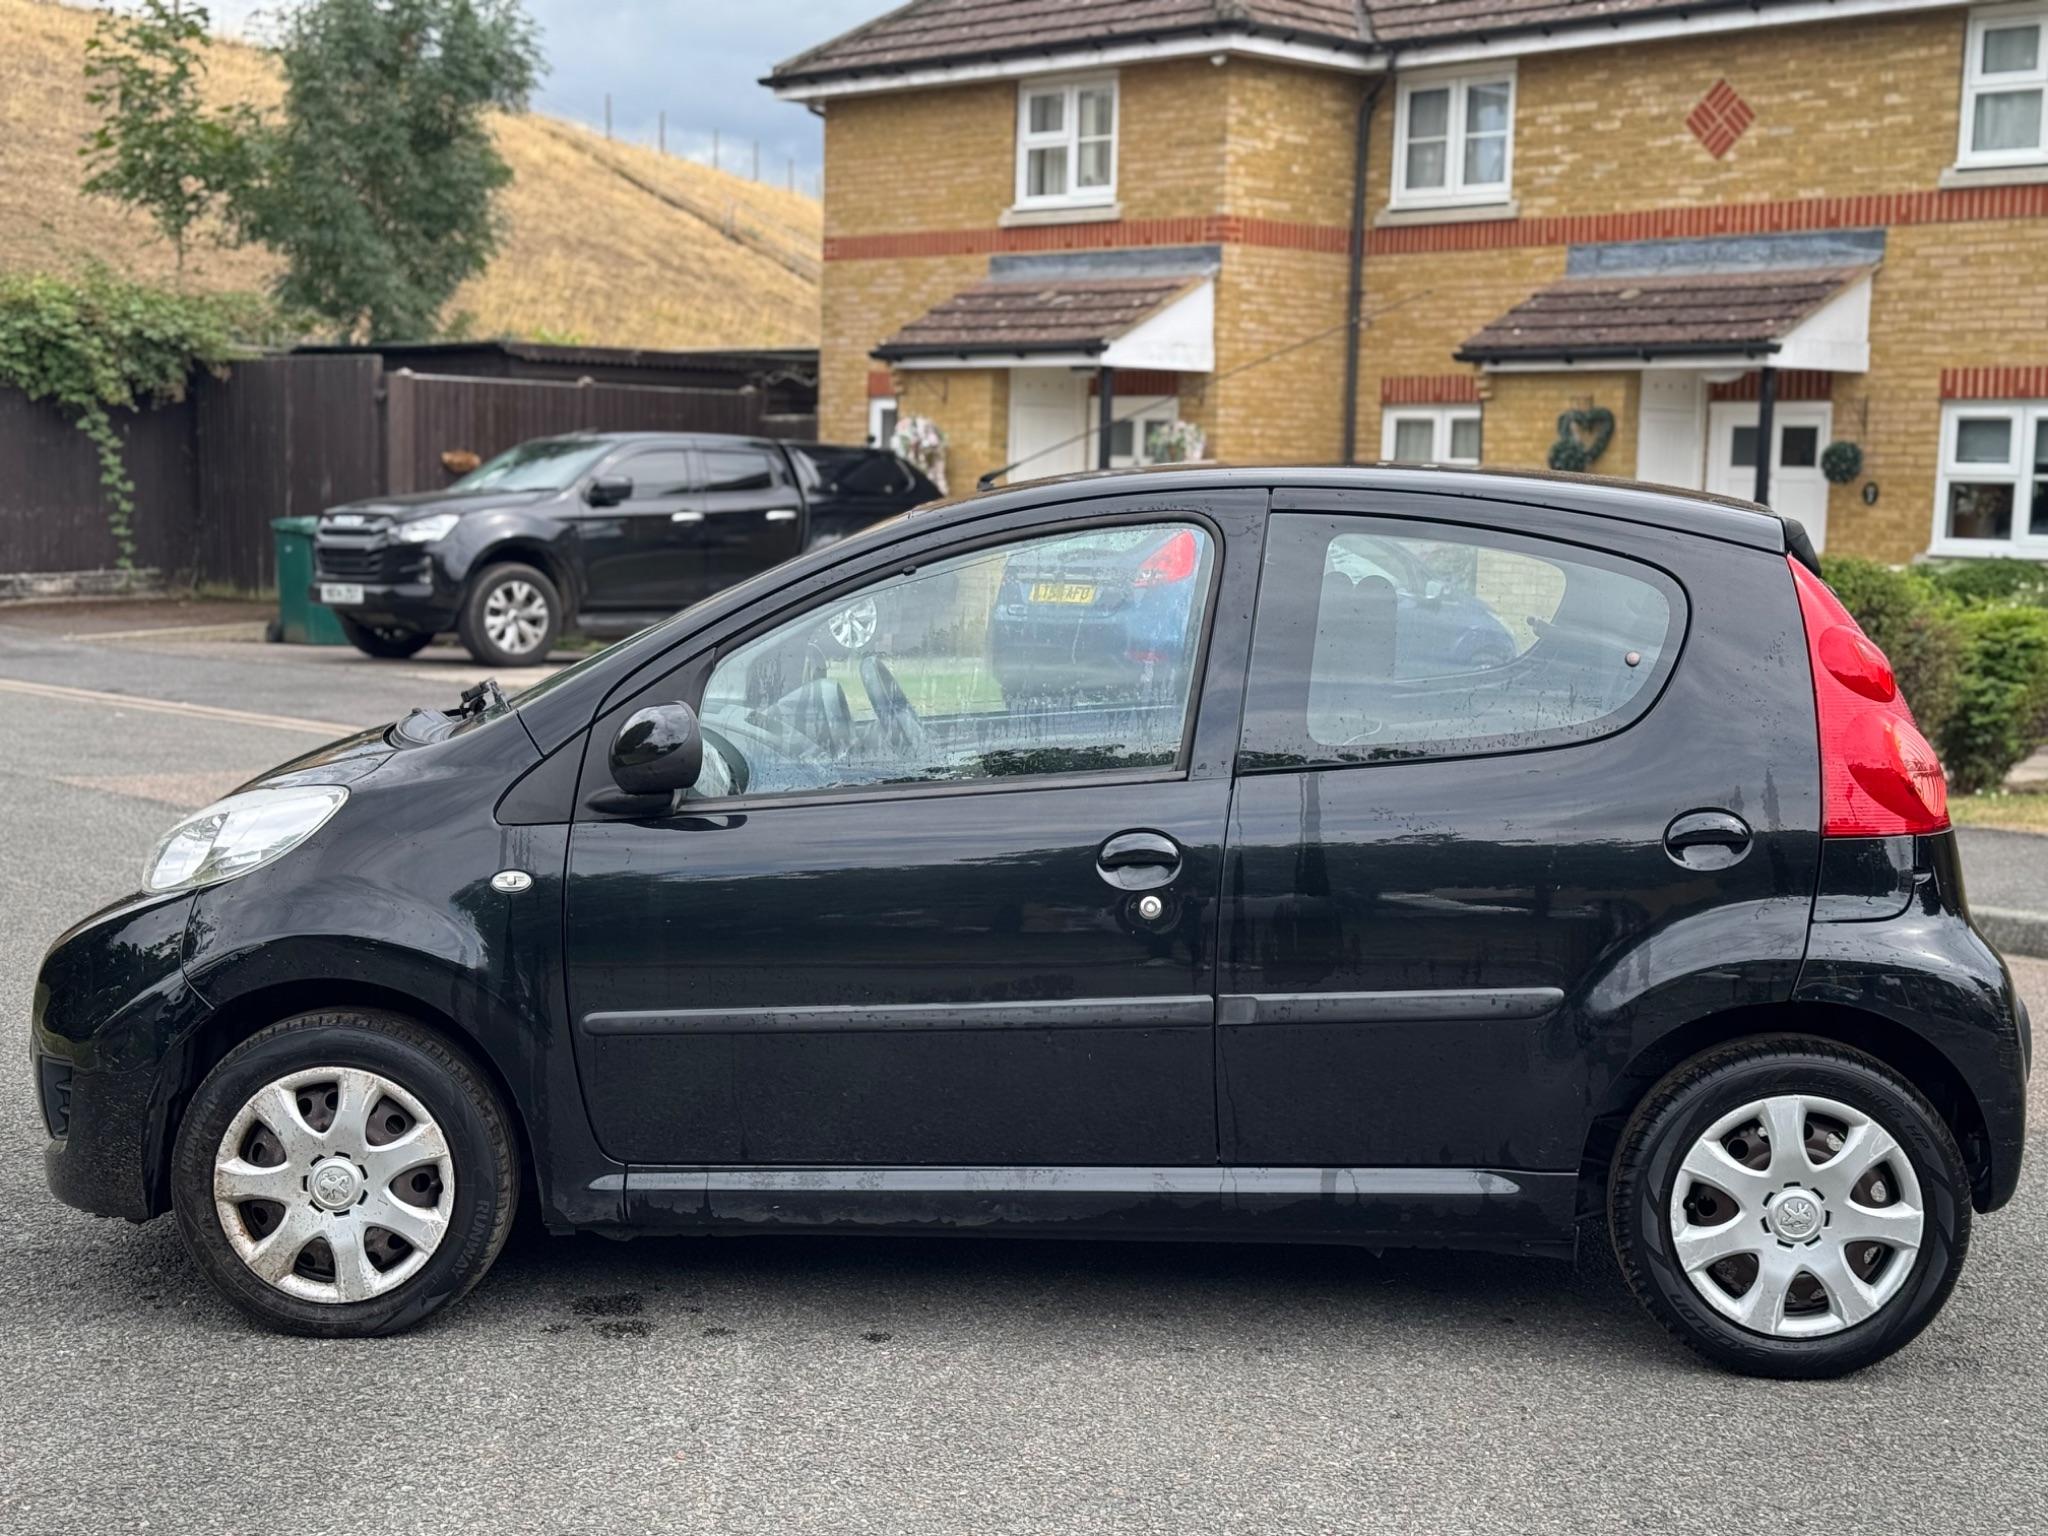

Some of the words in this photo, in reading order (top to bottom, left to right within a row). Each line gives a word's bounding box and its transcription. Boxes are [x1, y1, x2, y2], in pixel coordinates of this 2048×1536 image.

[181, 1089, 218, 1174] RUNWAY
[1904, 1125, 1930, 1149] HP
[451, 1199, 490, 1280] RUNWAY
[1668, 1294, 1771, 1356] EXCELON
